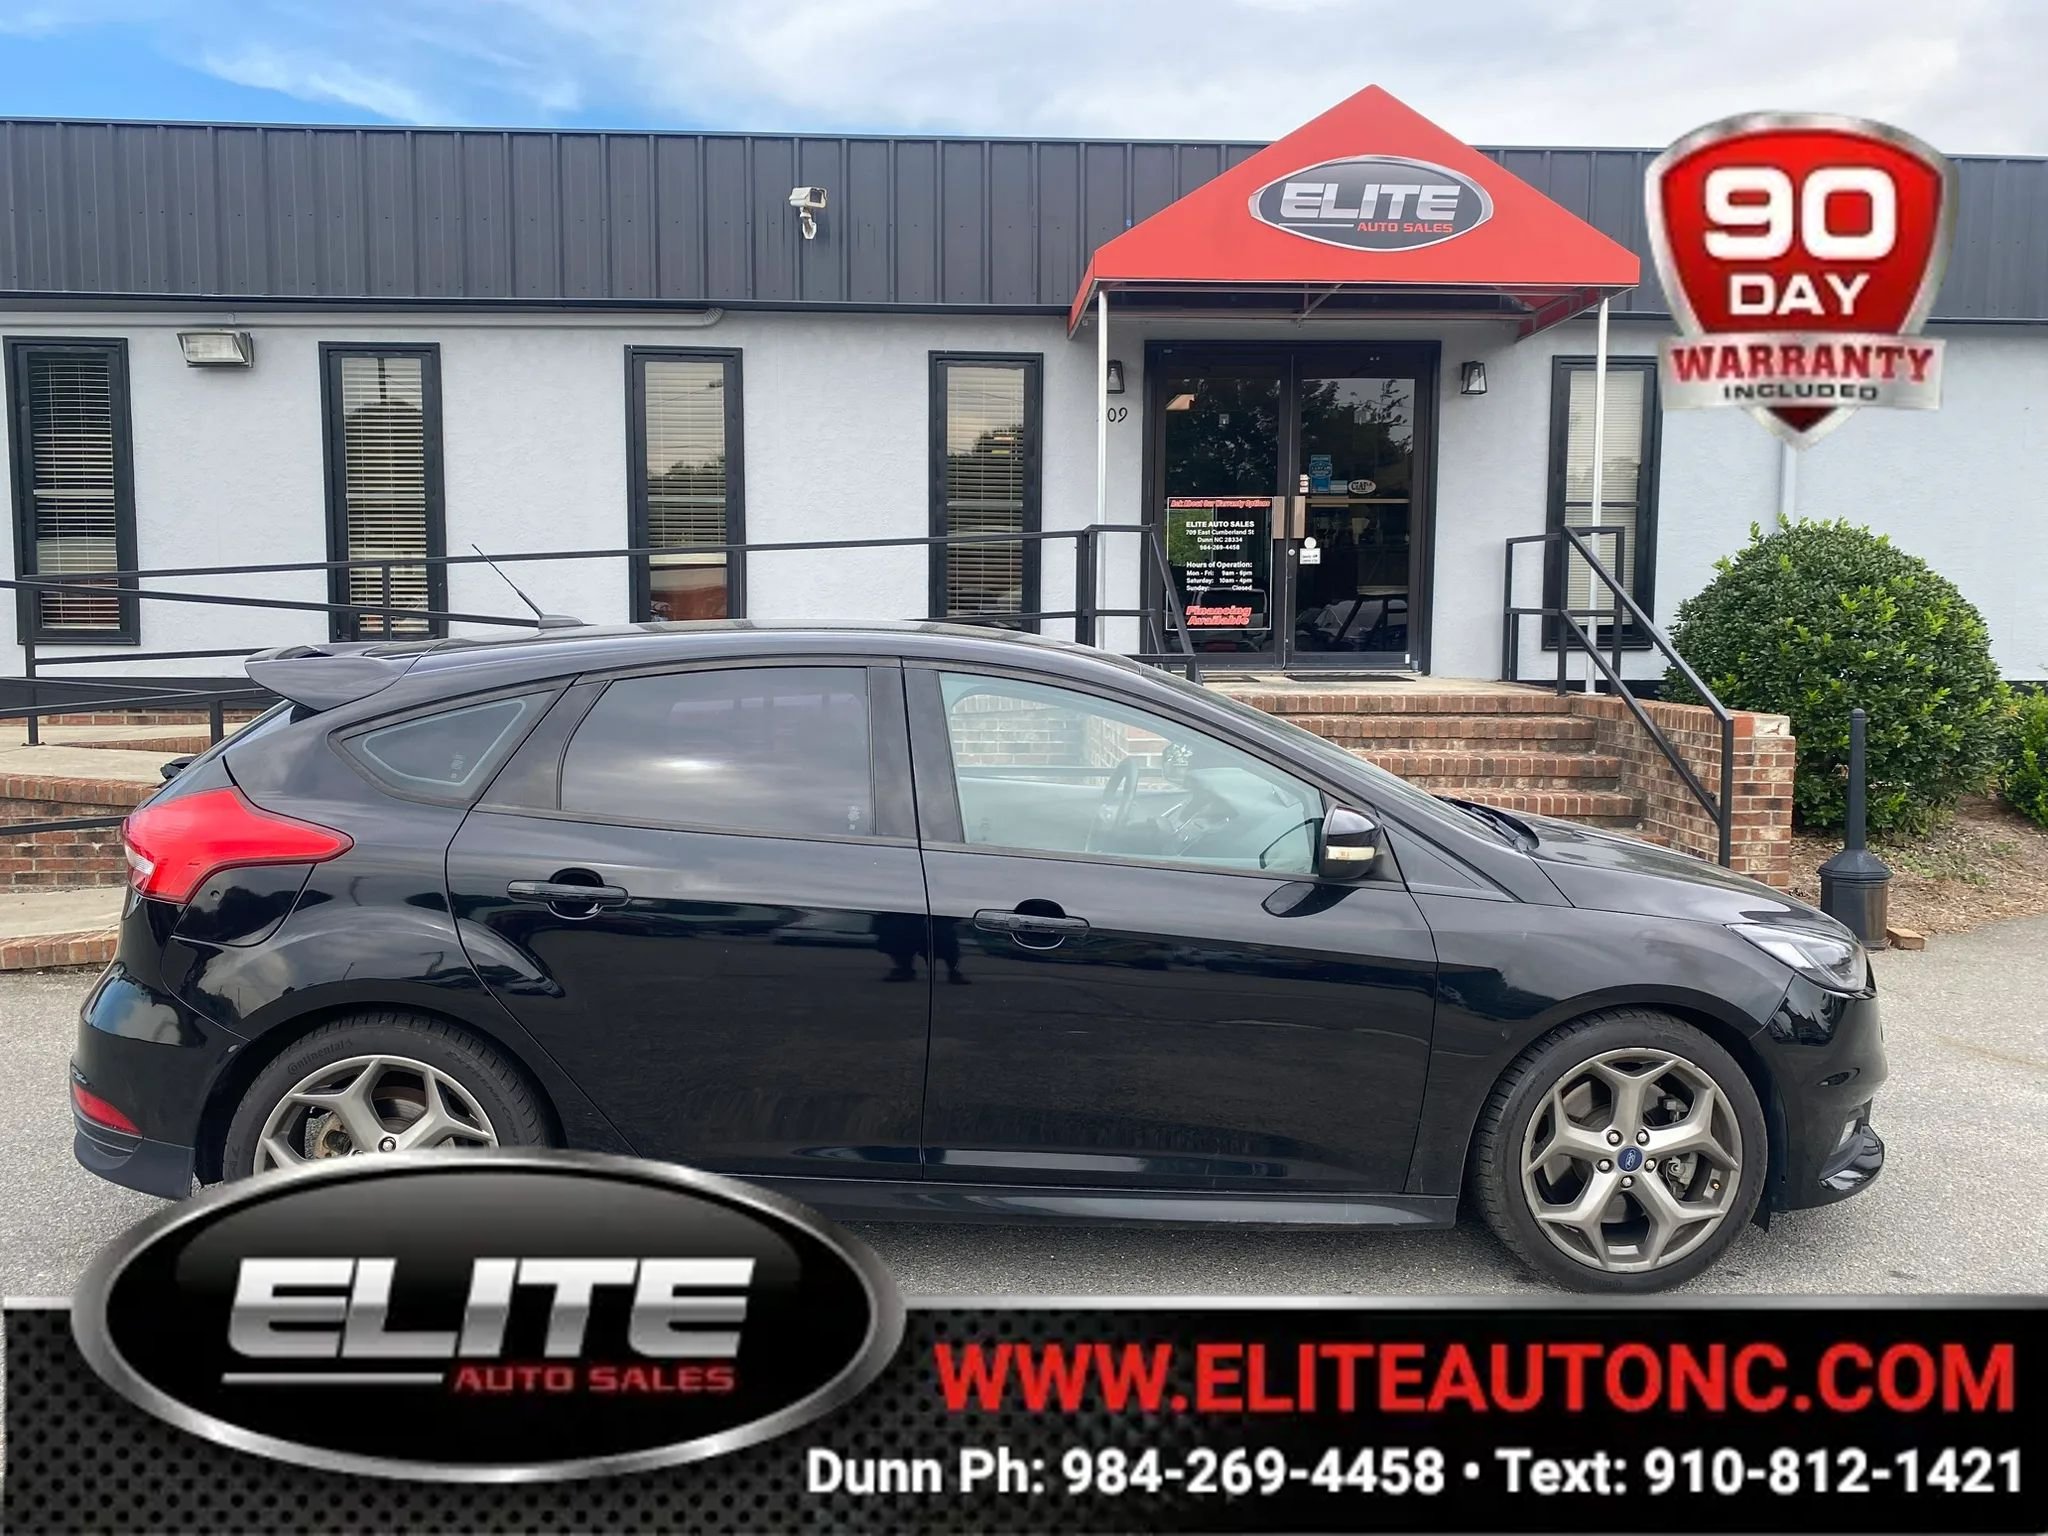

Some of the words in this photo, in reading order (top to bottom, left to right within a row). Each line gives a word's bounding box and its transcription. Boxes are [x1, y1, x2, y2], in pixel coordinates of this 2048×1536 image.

[1280, 182, 1461, 221] ELITE
[1356, 222, 1398, 233] AUTO
[1403, 222, 1453, 234] SALES
[1104, 407, 1128, 423] 09
[1216, 561, 1253, 569] Operation:
[1186, 605, 1252, 617] Financing
[1187, 615, 1249, 625] Available
